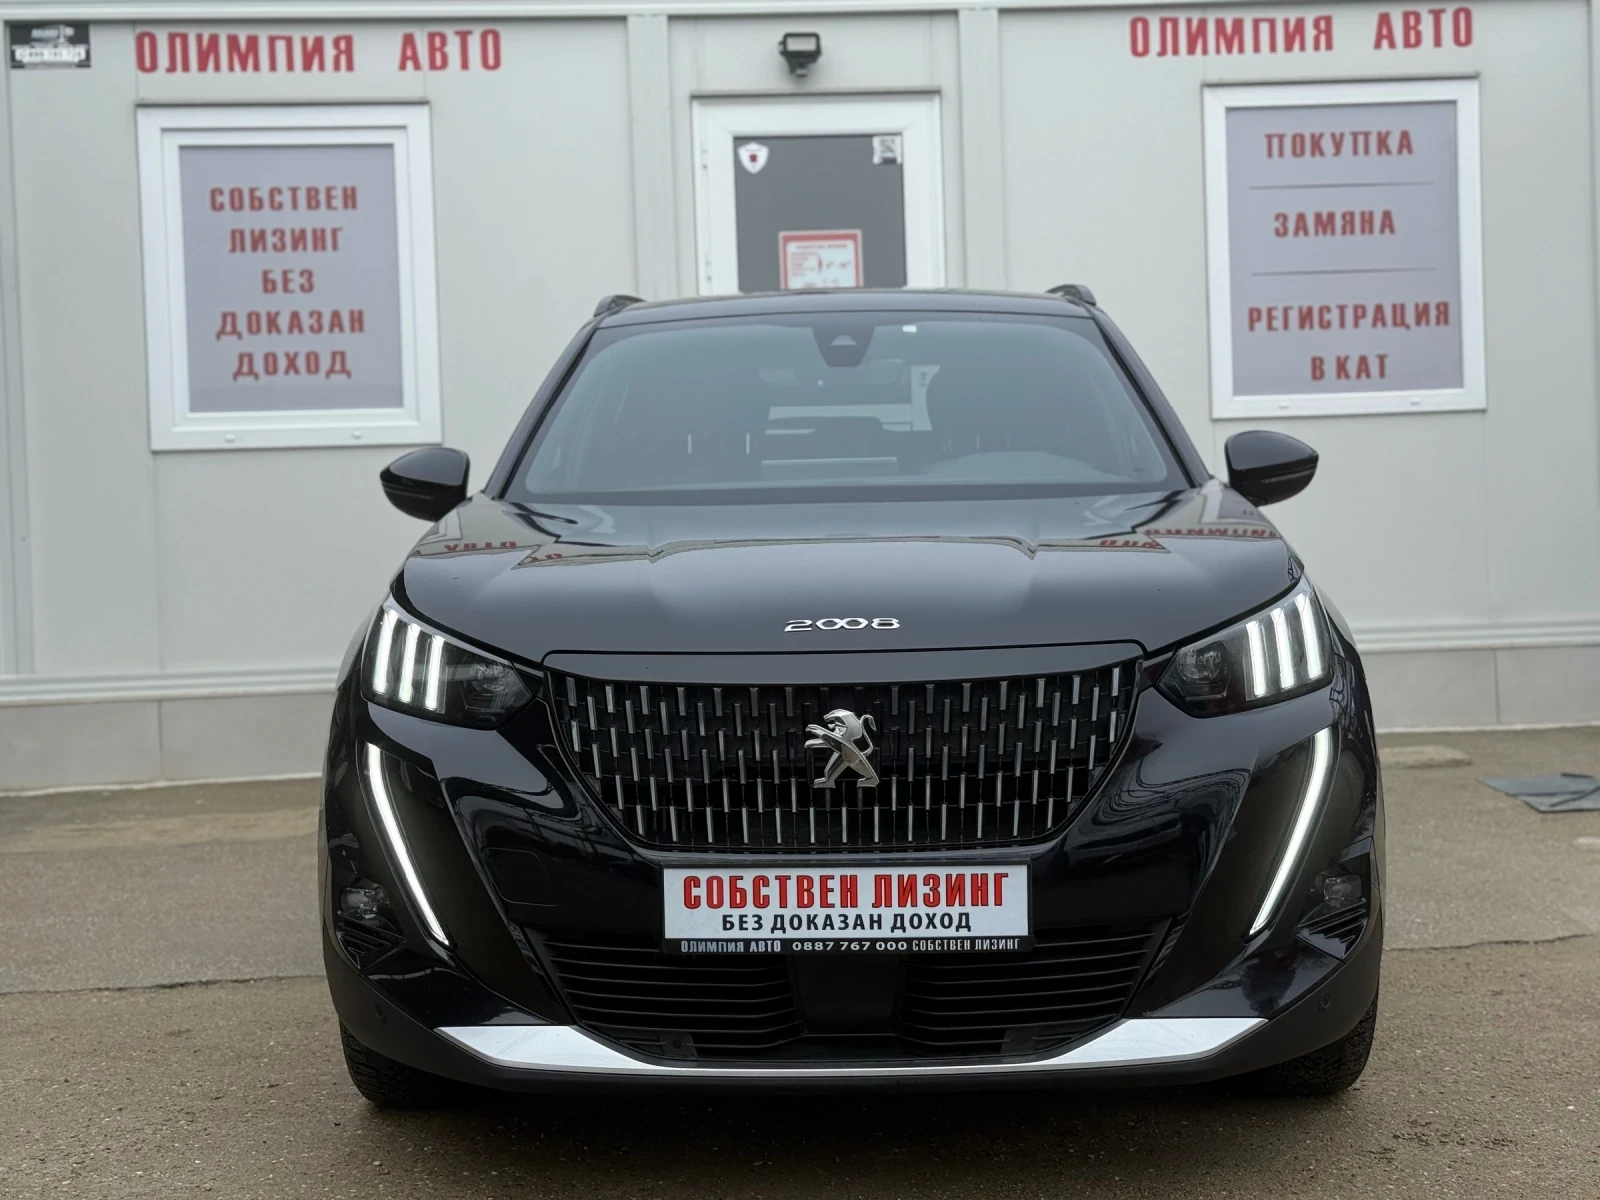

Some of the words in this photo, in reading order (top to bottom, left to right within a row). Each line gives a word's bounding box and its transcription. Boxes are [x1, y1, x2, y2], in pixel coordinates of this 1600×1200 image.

[1128, 14, 1334, 58] ОЛИМПИЯ
[1373, 6, 1474, 51] АВТО
[135, 30, 356, 74] ОЛИМПИЯ
[398, 28, 502, 72] АВТО
[1264, 129, 1414, 159] ПОКУПКА
[209, 186, 358, 212] СОБСТВЕН
[1274, 209, 1395, 238] ЗАМЯНА
[229, 227, 343, 253] ЛИЗИНГ
[262, 269, 315, 294] БЕЗ
[216, 309, 365, 341] ДОКАЗАН
[1248, 301, 1450, 332] РЕГИСТРАЦИЯ
[232, 350, 352, 381] ДОХОД
[1311, 356, 1326, 381] В
[1335, 354, 1388, 380] КАТ
[784, 617, 901, 632] 2008
[683, 874, 859, 910] СОБСТВЕН
[871, 872, 1009, 909] ЛИЗИНГ
[721, 913, 764, 932] БЕЗ
[770, 912, 883, 934] ДОКАЗАН
[890, 911, 972, 933] ДОХОД
[680, 940, 744, 953] ОЛИМПИЯ
[749, 939, 781, 953] АВТО
[792, 941, 834, 951] 0887
[839, 941, 871, 951] 767
[875, 941, 908, 951] 000
[912, 939, 971, 951] СОБСТВЕН
[974, 938, 1020, 951] ЛИЗИНГ
